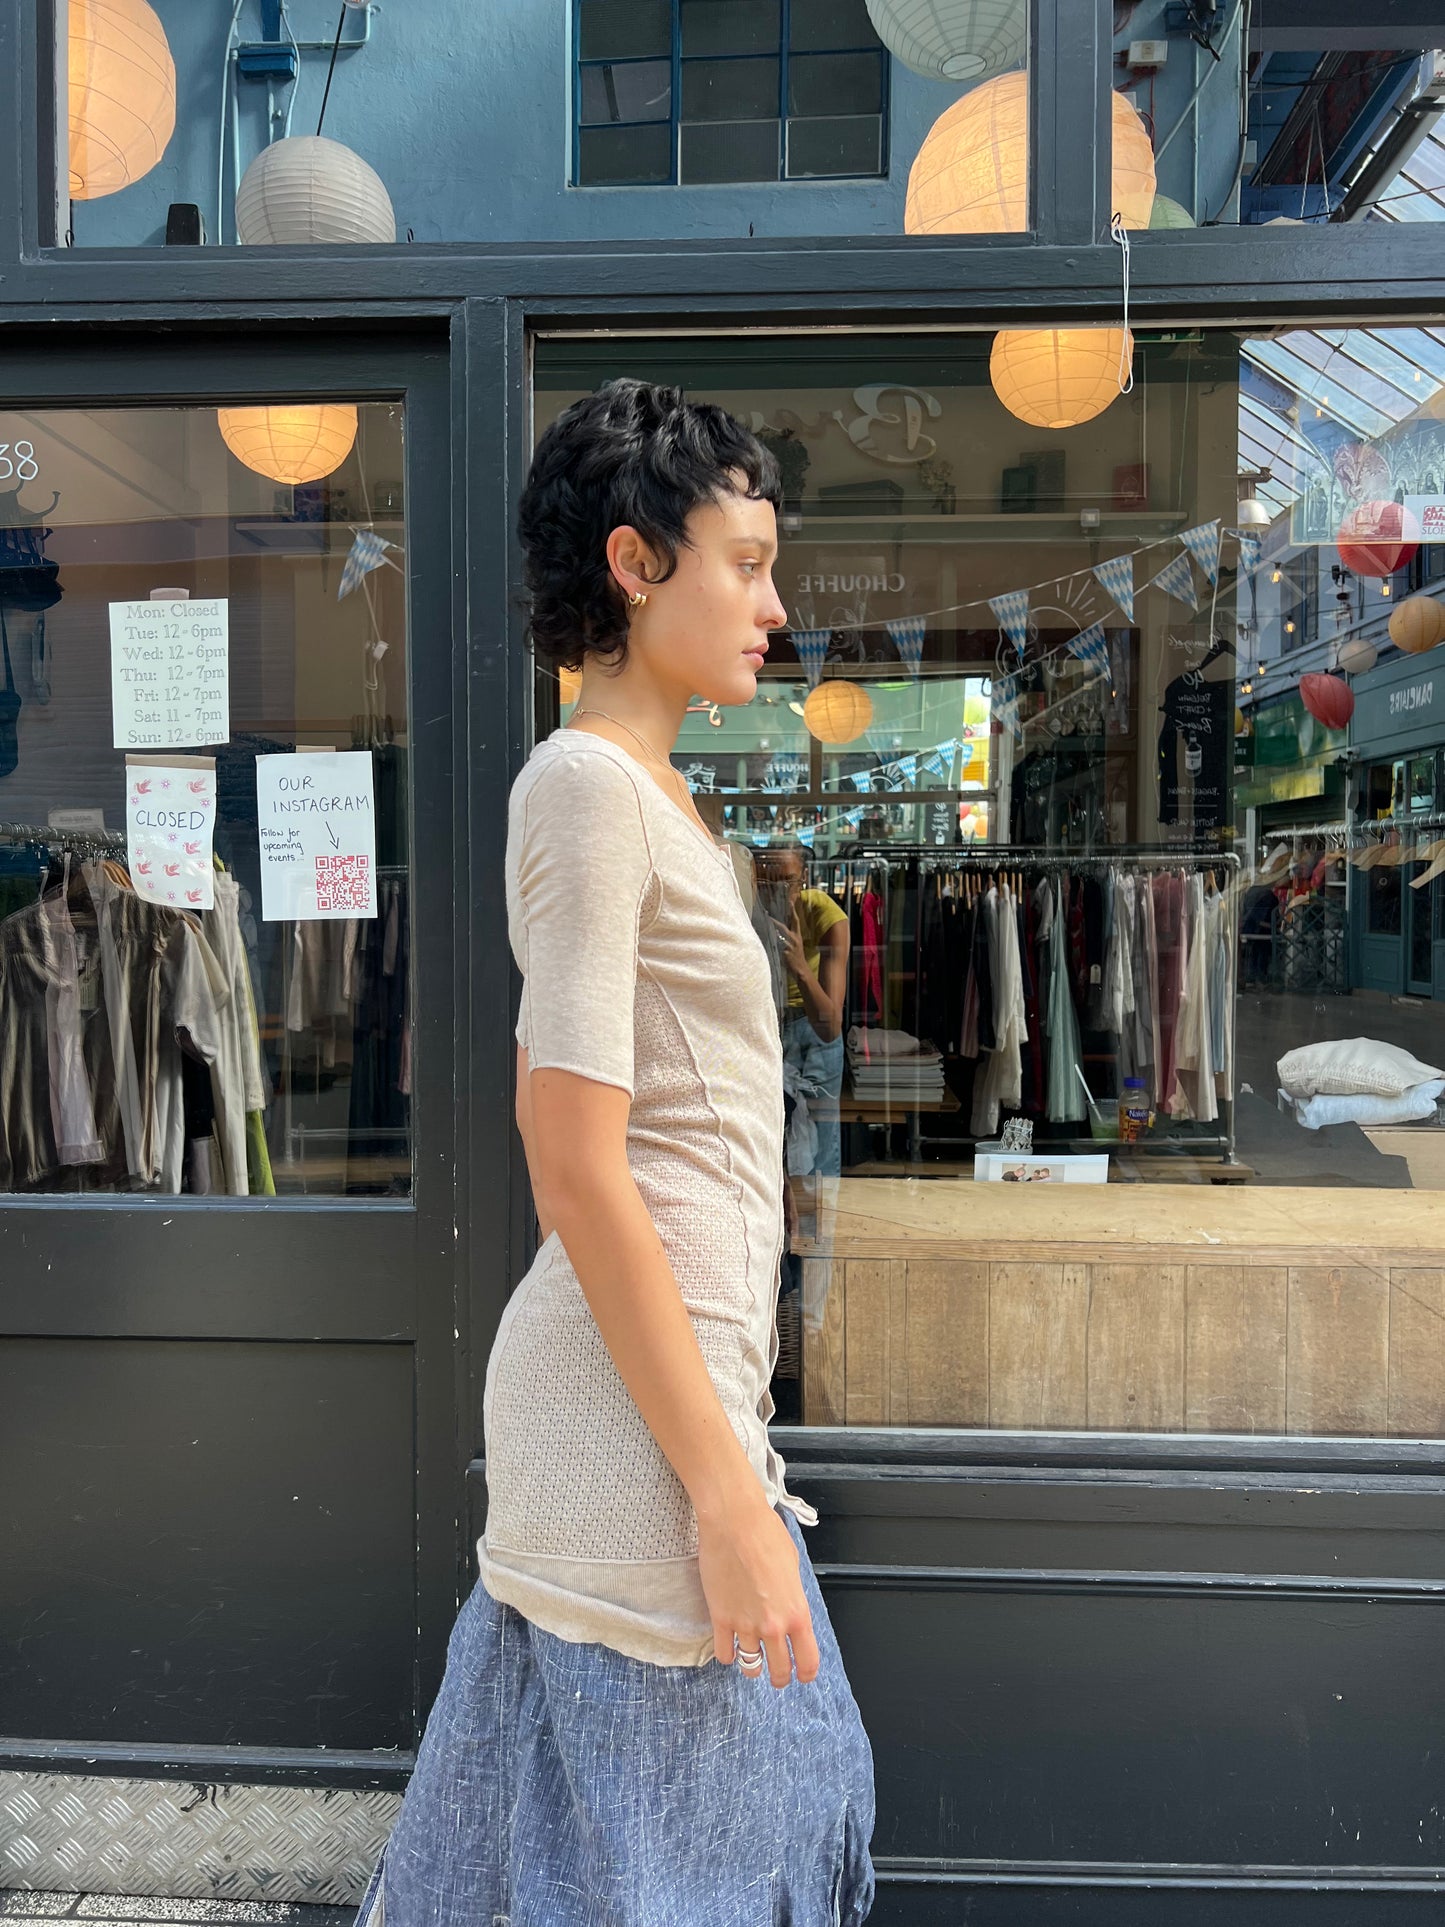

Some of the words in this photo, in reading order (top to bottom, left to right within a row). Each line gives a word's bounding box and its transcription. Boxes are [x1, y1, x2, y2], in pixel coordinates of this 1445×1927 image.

[126, 605, 165, 619] Mon:
[170, 602, 219, 617] Closed
[124, 626, 158, 640] Tue:
[122, 646, 164, 661] Wed:
[120, 667, 157, 682] Thu:
[133, 688, 159, 702] Fri:
[134, 709, 161, 723] Sat:
[128, 729, 161, 744] Sun:
[279, 775, 315, 791] OUR
[273, 795, 370, 813] INSTAGRAM
[136, 810, 205, 830] CLOSED
[260, 828, 284, 838] Follow
[287, 827, 301, 843] for
[263, 842, 304, 856] upcoming
